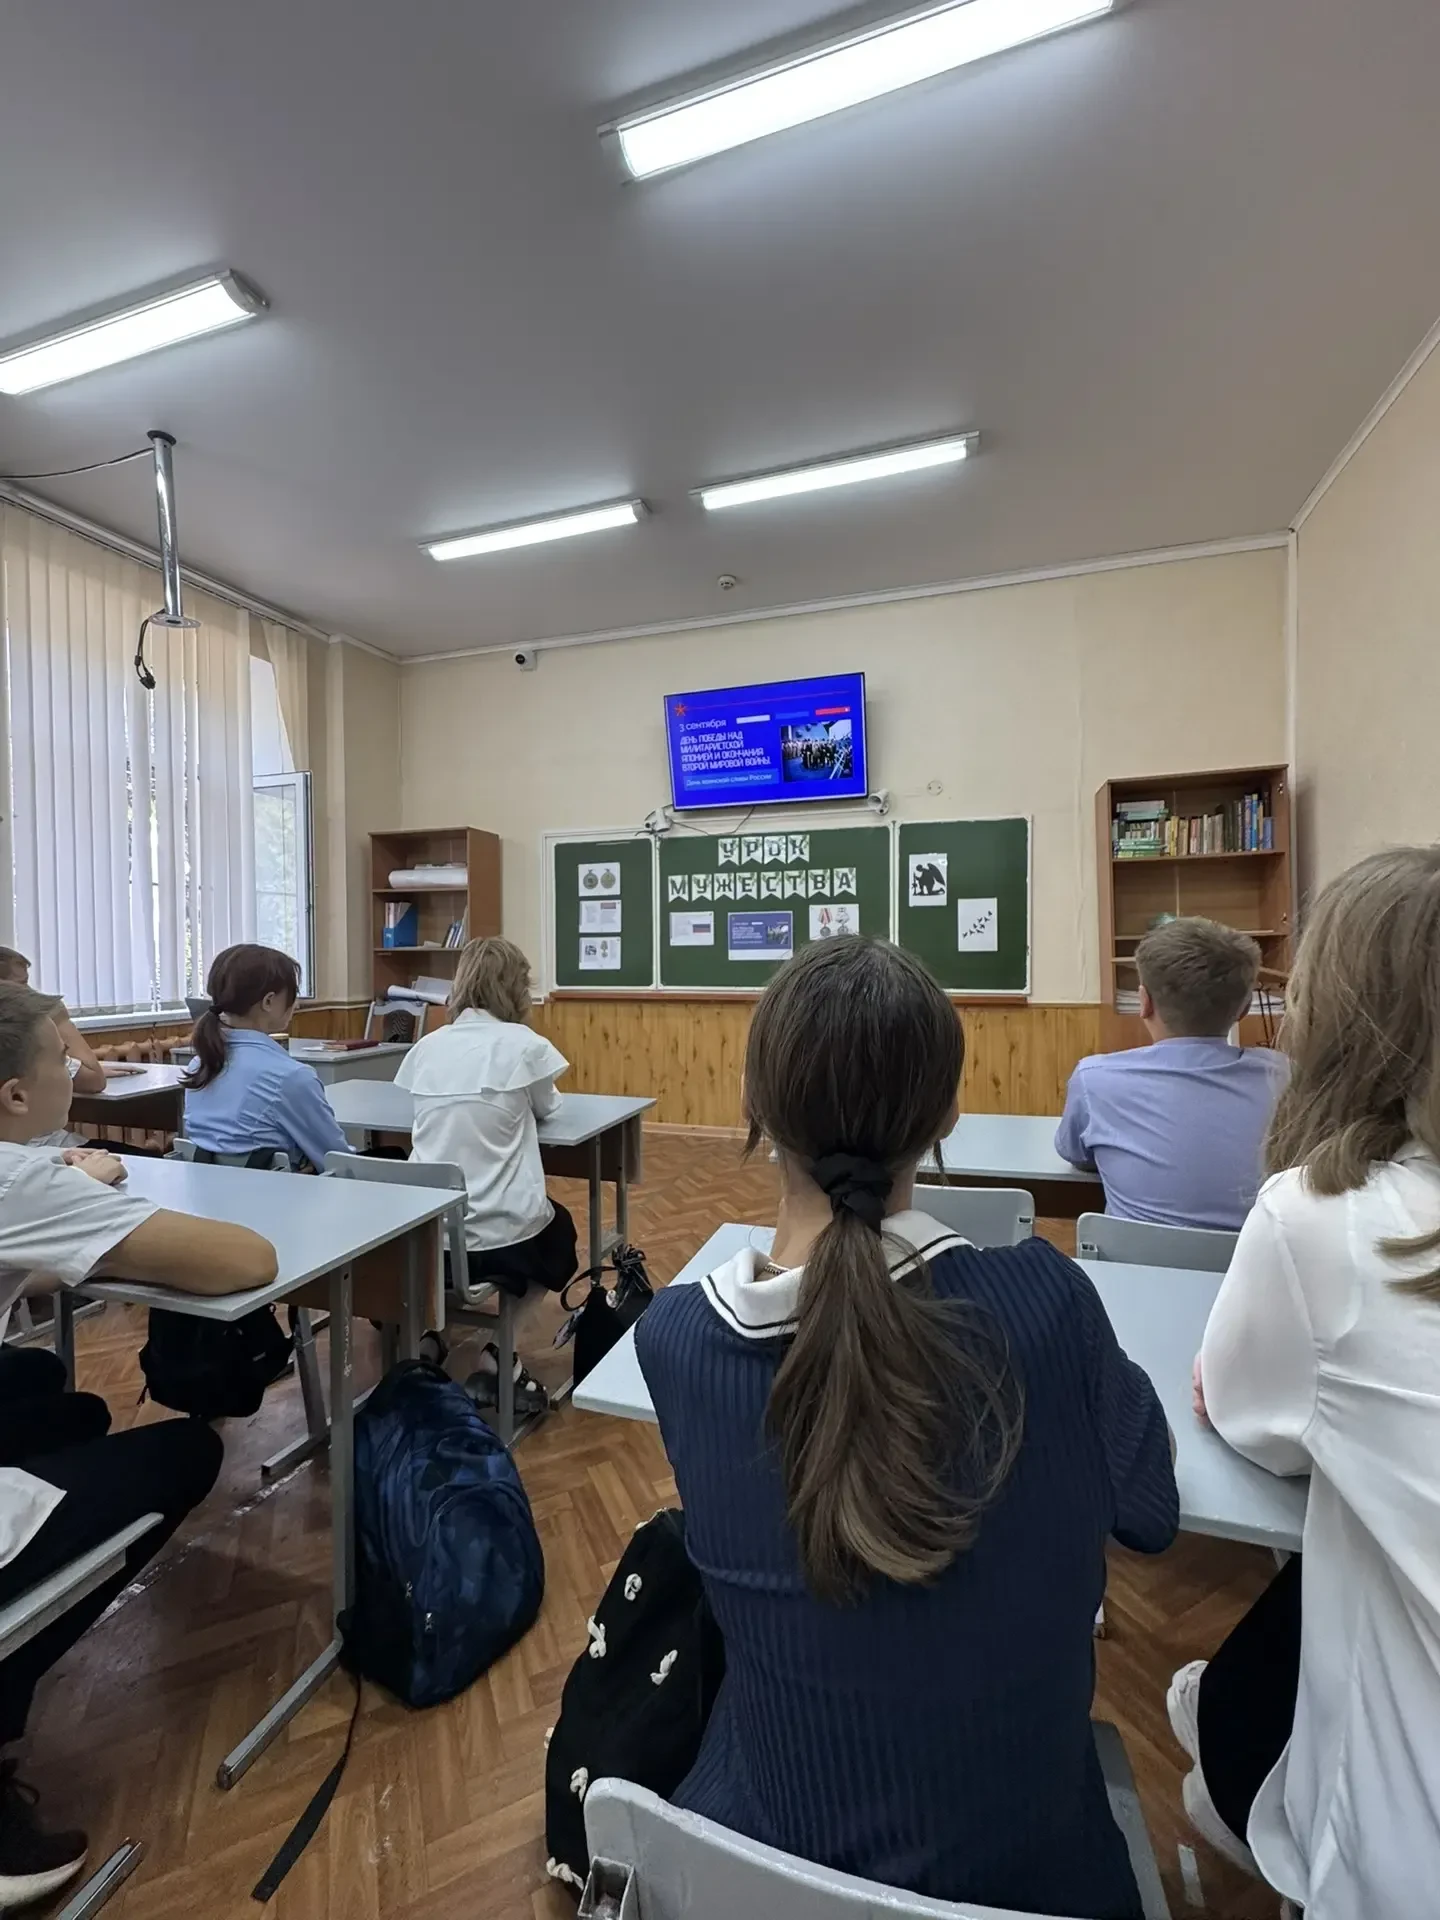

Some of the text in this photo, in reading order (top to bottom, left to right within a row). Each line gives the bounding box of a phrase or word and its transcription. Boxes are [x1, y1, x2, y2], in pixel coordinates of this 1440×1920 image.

[679, 719, 726, 732] 3 сентября
[680, 731, 744, 745] ДЕНЬ ПОБЕДЫ НАД
[714, 750, 720, 760] И
[682, 760, 708, 772] ВТОРОЙ
[709, 757, 744, 770] МИРОВОЙ
[722, 840, 806, 858] УРОК
[670, 872, 853, 896] МУЖЕСТВА
